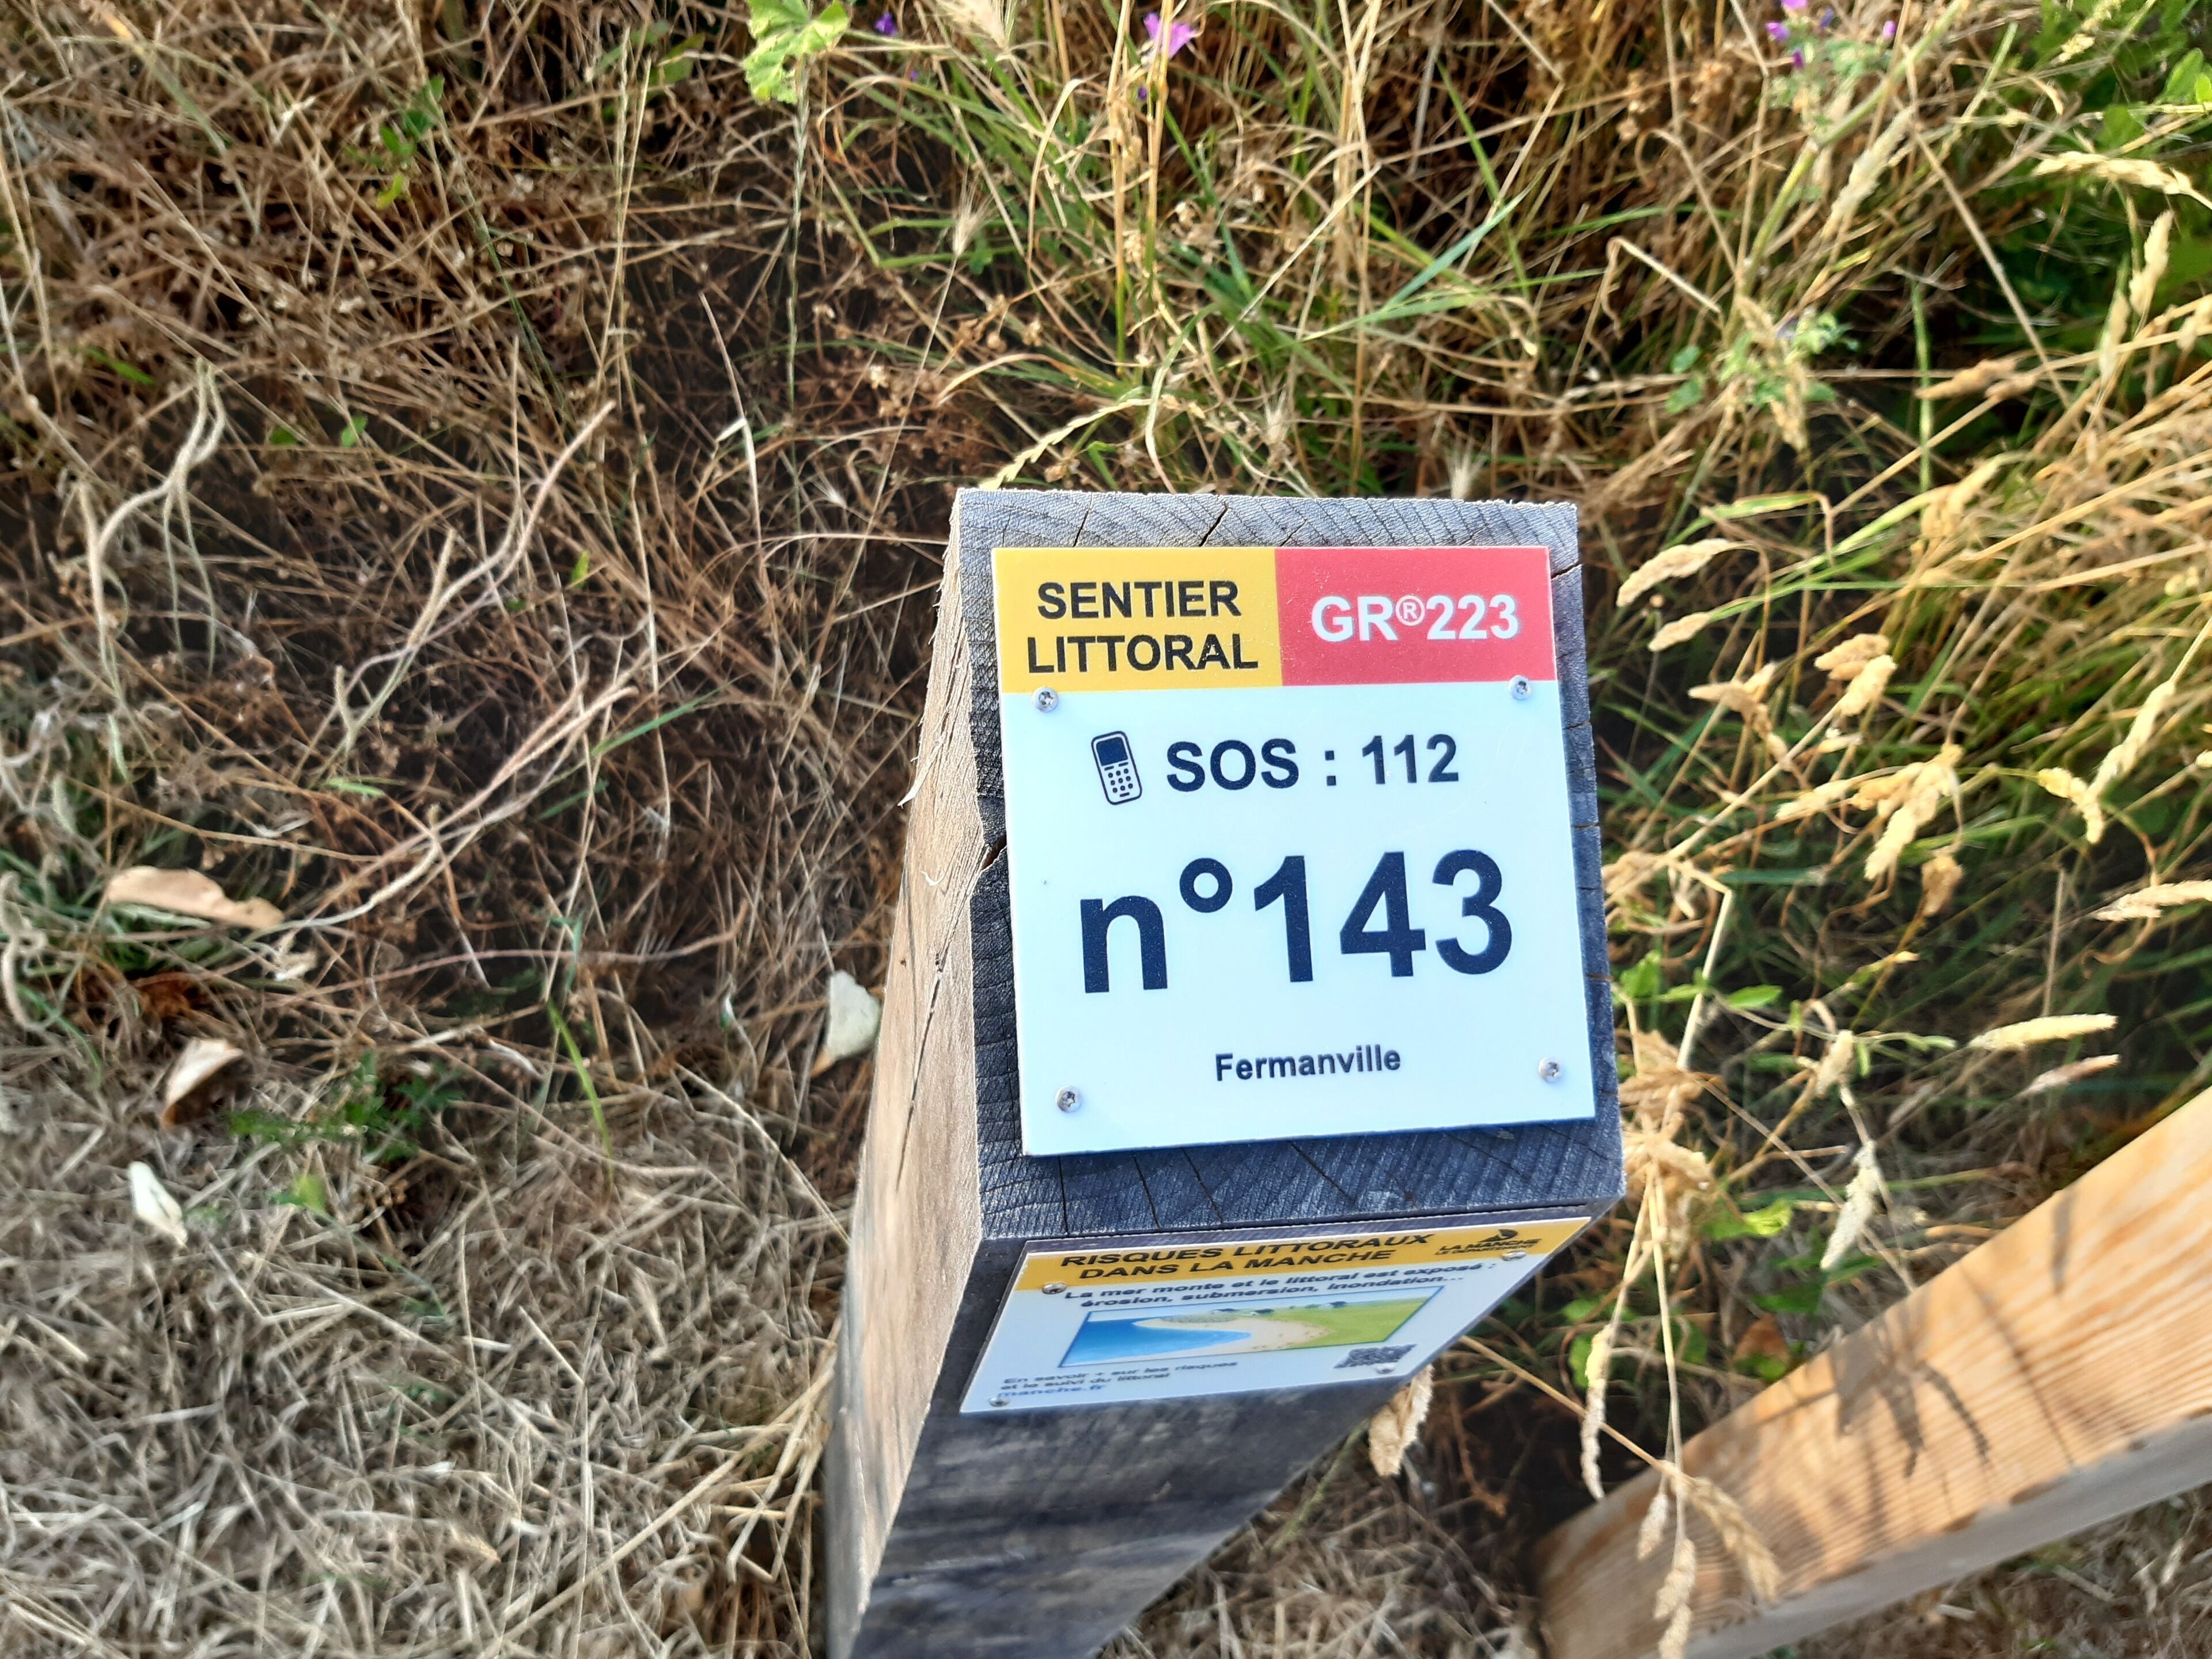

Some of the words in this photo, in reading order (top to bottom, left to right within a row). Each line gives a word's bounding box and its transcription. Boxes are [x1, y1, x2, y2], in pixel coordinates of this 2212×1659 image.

[1037, 580, 1241, 620] SENTIER
[1027, 634, 1258, 674] LITTORAL
[1166, 738, 1299, 792] SOS
[1326, 751, 1336, 786] :
[1362, 733, 1459, 784] 112
[1080, 849, 1512, 994] n°143
[1215, 1044, 1401, 1081] Fermanville
[1061, 1248, 1224, 1267] RISQUES
[1233, 1234, 1435, 1256] LITTORAUX
[1080, 1264, 1180, 1279] DANS
[1190, 1260, 1234, 1272] LA
[1244, 1249, 1396, 1268] MANCHE
[1100, 1287, 1147, 1296] mer
[1152, 1282, 1225, 1293] monte
[1232, 1279, 1254, 1288] et
[1286, 1272, 1359, 1284] littoral
[1364, 1269, 1399, 1278] est
[1404, 1263, 1483, 1276] exposé
[1081, 1296, 1173, 1307] érosion,
[1181, 1286, 1318, 1301] submersion,
[1117, 1373, 1171, 1381] littoral
[1175, 1362, 1238, 1370] risques
[998, 1384, 1105, 1396] manche.fr
